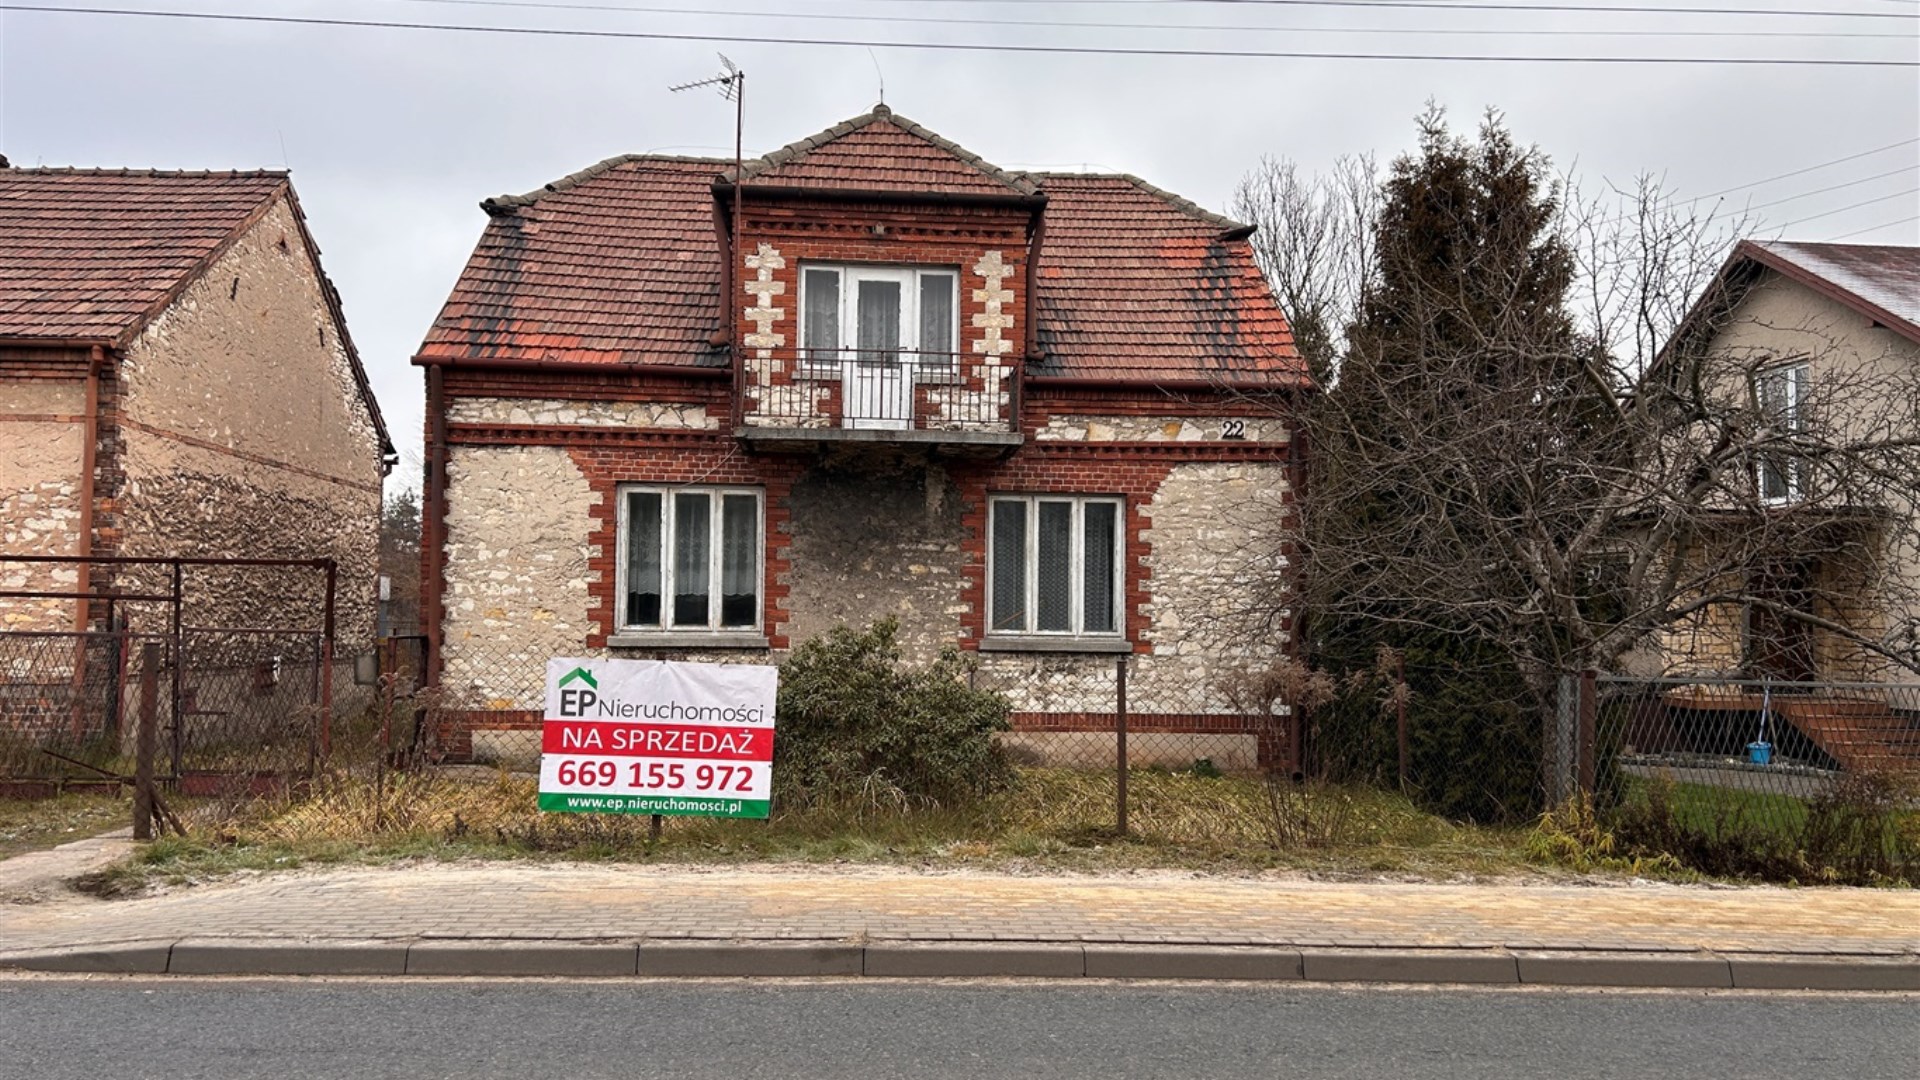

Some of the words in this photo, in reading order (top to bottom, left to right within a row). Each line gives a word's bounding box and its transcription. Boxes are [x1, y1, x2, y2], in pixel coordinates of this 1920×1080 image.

[1222, 420, 1246, 439] 22
[559, 689, 597, 717] EP
[598, 699, 764, 723] Nieruchomości
[562, 727, 603, 748] NA
[611, 728, 754, 754] SPRZEDAŻ
[558, 760, 617, 787] 669
[628, 762, 685, 788] 155
[696, 764, 753, 791] 972
